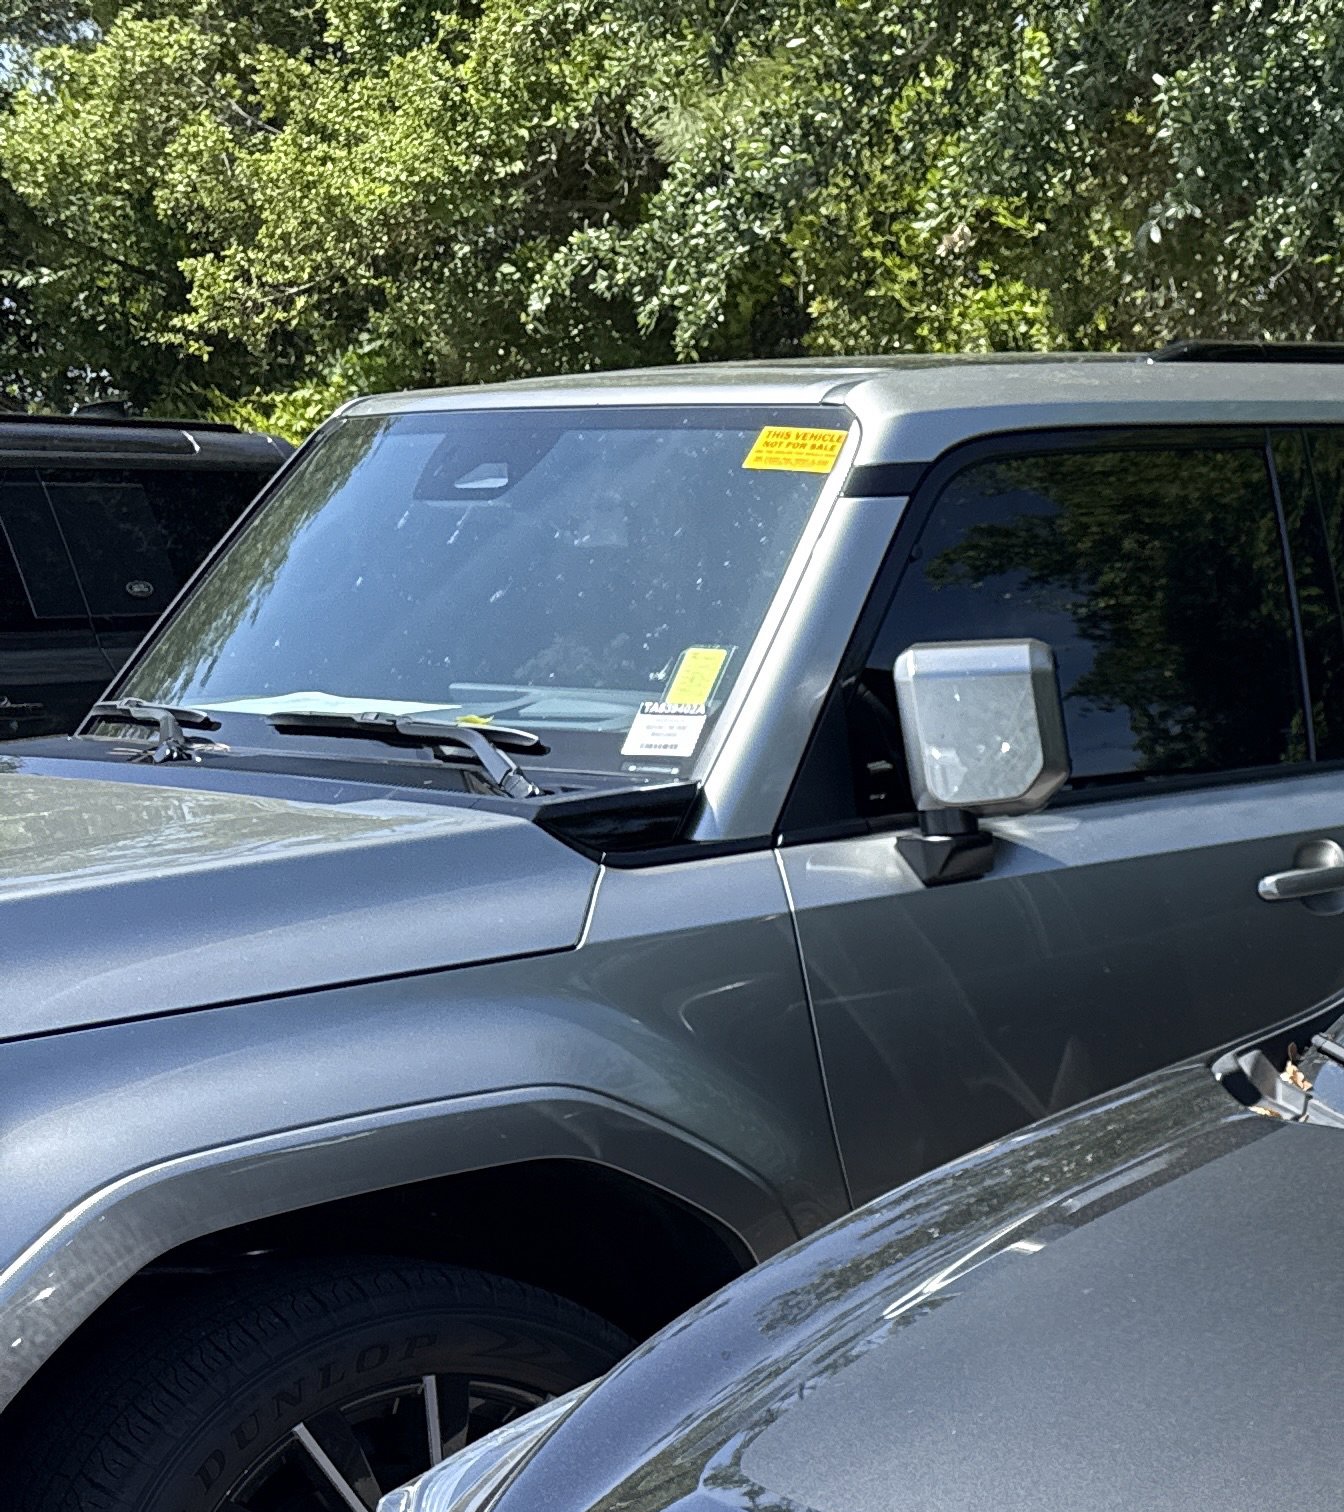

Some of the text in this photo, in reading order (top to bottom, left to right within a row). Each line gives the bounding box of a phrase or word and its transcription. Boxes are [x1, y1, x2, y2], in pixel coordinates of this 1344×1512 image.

[766, 430, 844, 443] THIS VEHICLE
[762, 440, 837, 452] NOT FOR SALE
[194, 1333, 438, 1495] DUNLOP
